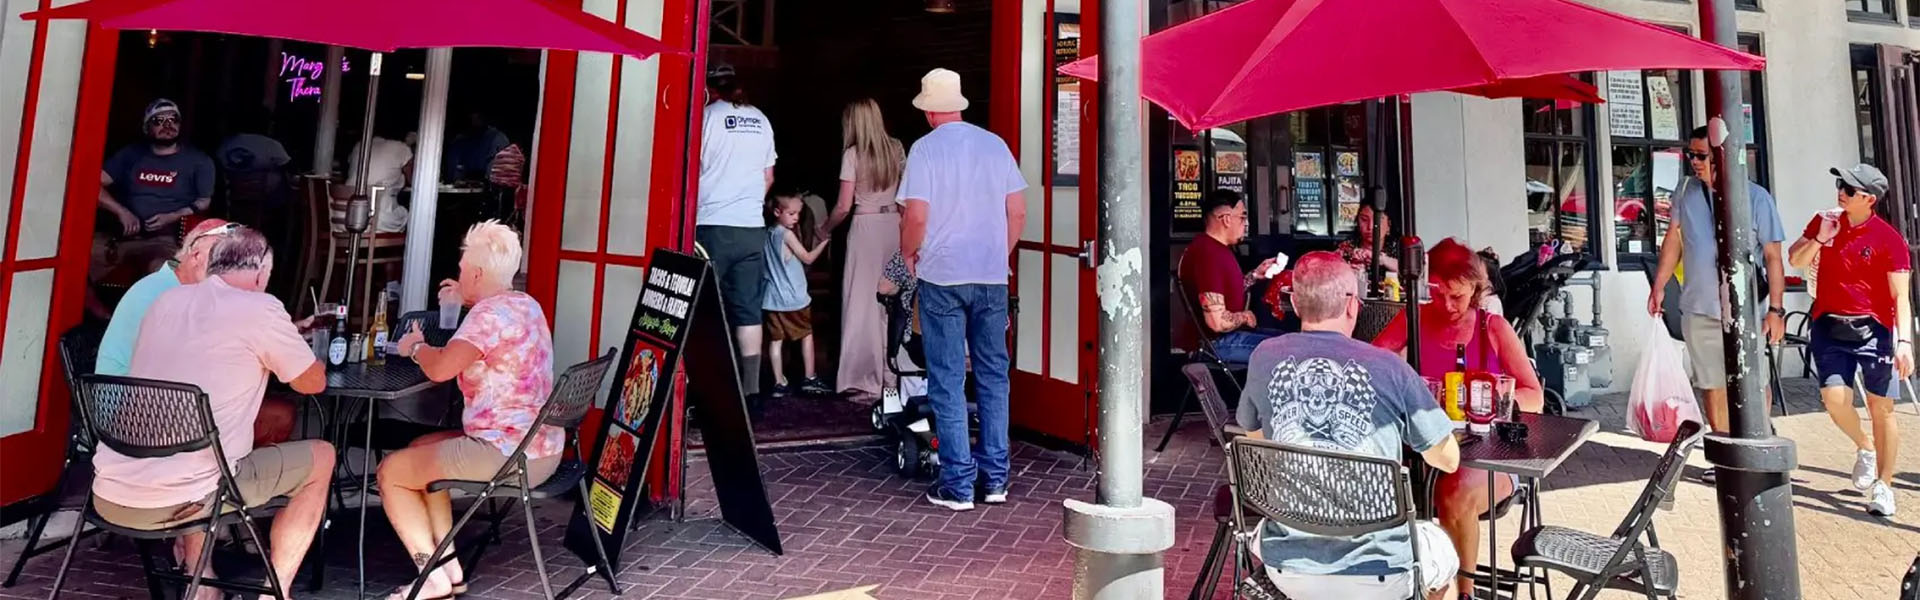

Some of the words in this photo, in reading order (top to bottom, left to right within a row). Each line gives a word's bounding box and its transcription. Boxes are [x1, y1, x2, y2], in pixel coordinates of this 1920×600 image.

[1178, 183, 1198, 191] TACO
[1218, 177, 1242, 185] FAJITA
[648, 266, 668, 288] TACOS
[1338, 409, 1369, 432] SPEED
